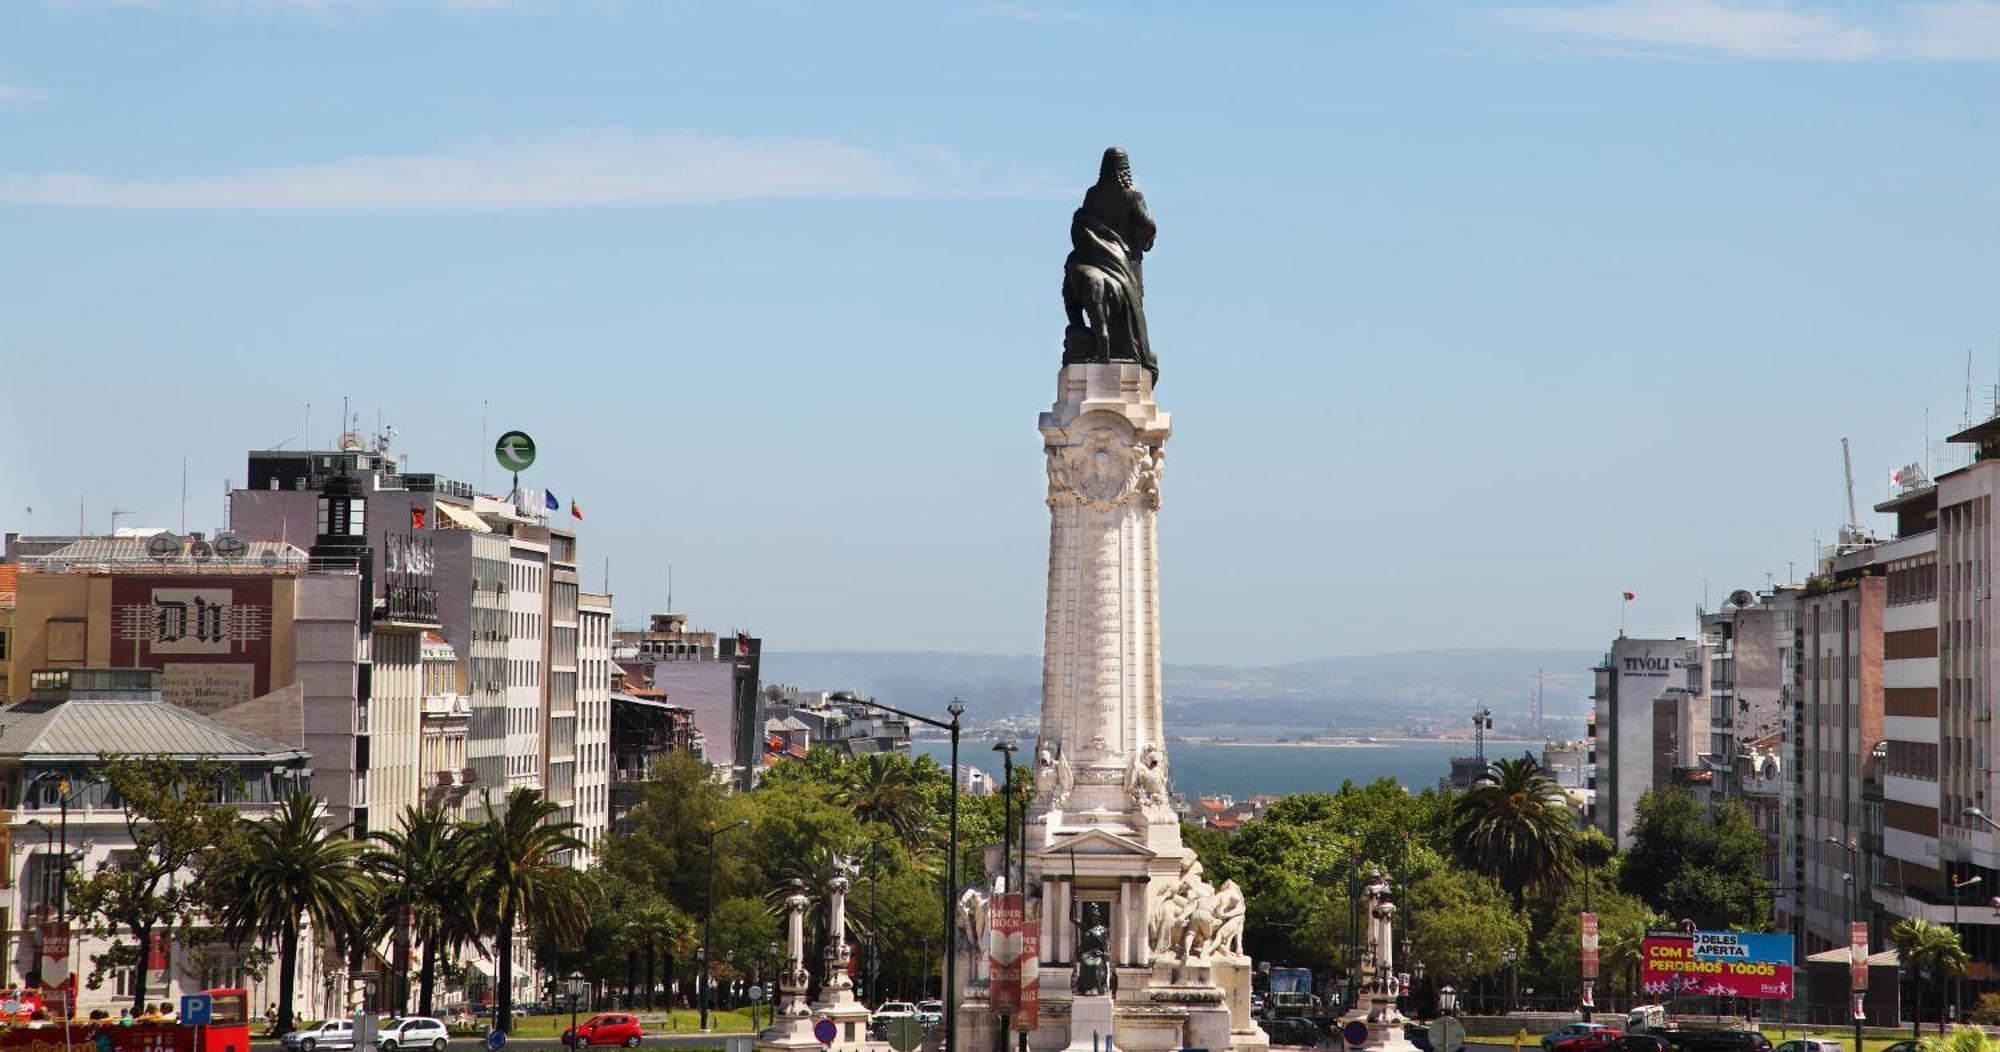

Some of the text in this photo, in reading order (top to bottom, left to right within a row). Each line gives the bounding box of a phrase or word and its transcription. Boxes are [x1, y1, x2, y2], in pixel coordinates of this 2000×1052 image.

[1623, 650, 1670, 670] TIVOLI
[1794, 627, 1804, 686] HOTEL
[1794, 833, 1804, 905] POMBAL
[991, 908, 1021, 919] SUPER
[1702, 935, 1737, 945] DELES
[1650, 946, 1682, 958] COM
[1697, 945, 1745, 956] APERTA
[1649, 960, 1723, 973] PERDEMOS
[187, 999, 204, 1020] P
